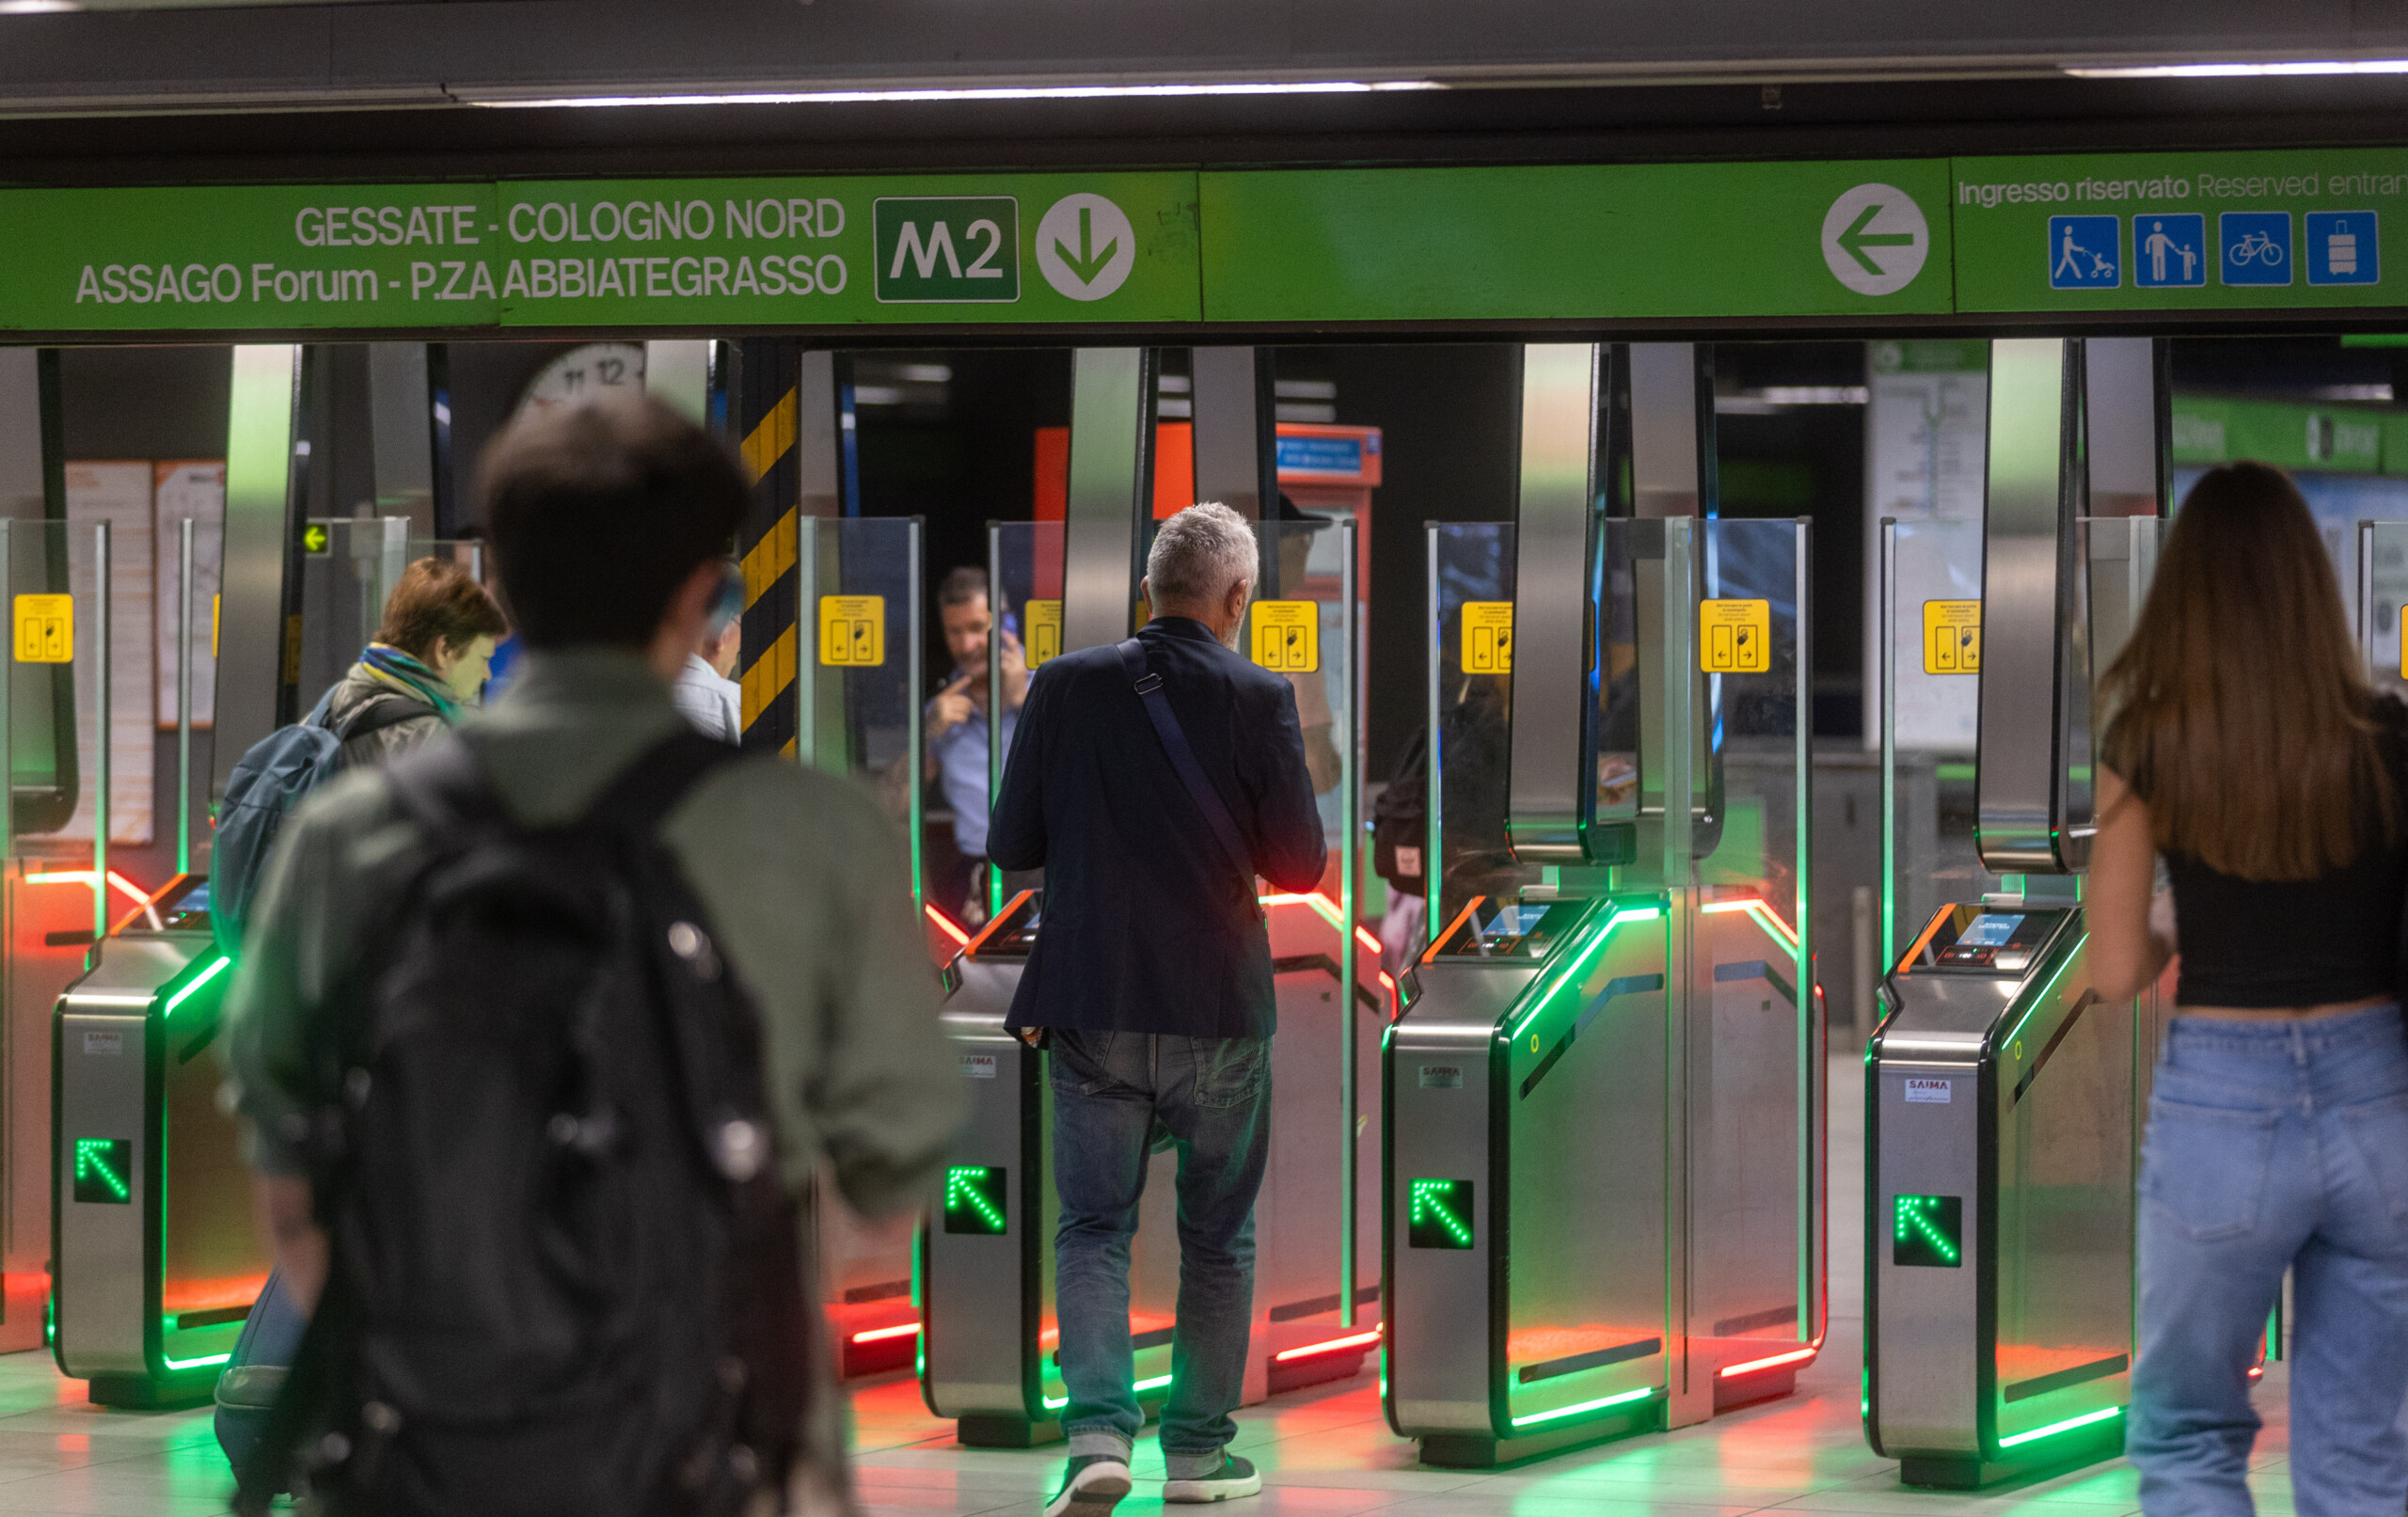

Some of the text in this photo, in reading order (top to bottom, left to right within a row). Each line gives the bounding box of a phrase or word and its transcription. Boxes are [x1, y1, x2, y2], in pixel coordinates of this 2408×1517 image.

[1958, 181, 2070, 210] Ingresso
[2075, 175, 2191, 201] riservato
[2197, 172, 2320, 198] Reserved
[295, 206, 481, 248] GESSATE
[508, 200, 716, 244] COLOGNO
[726, 198, 847, 241] NORD
[889, 218, 1005, 279] M2
[76, 263, 244, 304] ASSAGO
[252, 263, 380, 303] Forum
[411, 261, 498, 301] P.ZA
[502, 254, 848, 299] ABBIATEGRASSO
[597, 357, 625, 386] 12
[1909, 1080, 1949, 1090] SAIMA
